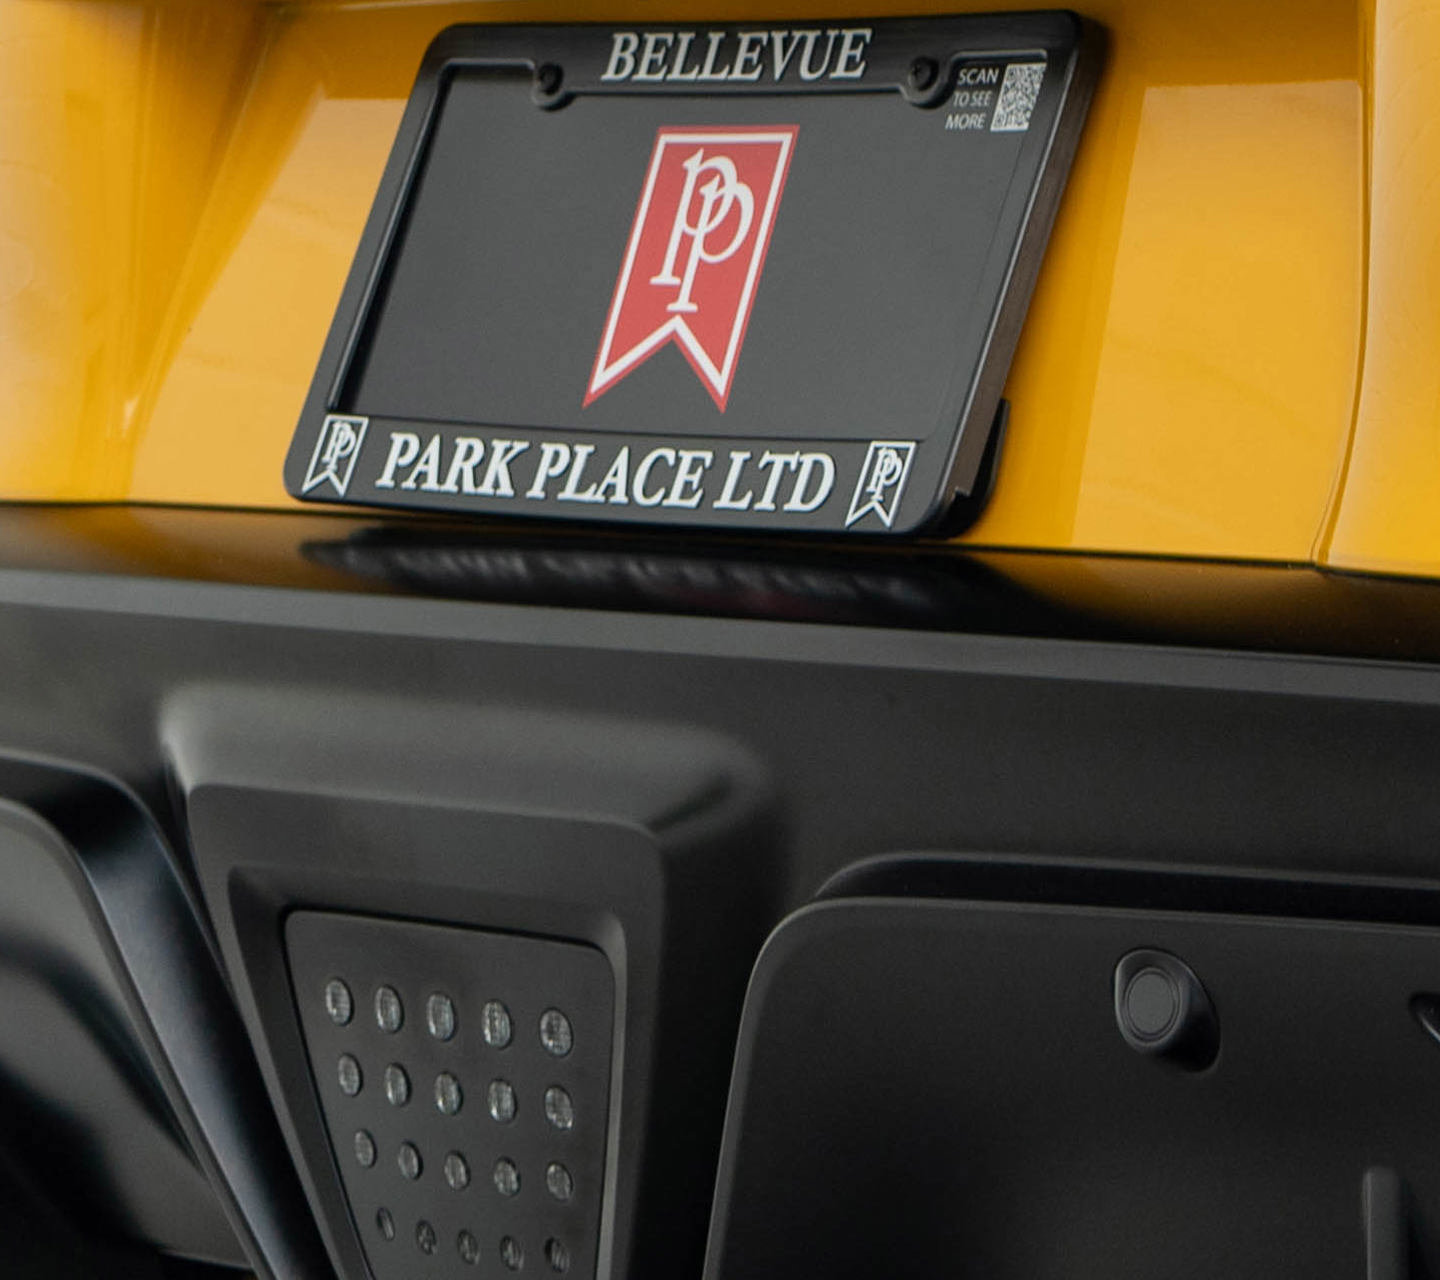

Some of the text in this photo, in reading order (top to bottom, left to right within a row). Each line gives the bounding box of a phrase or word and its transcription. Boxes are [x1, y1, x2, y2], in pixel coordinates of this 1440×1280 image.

[601, 27, 872, 82] BELLEVUE
[956, 67, 999, 85] SCAN
[953, 90, 992, 107] TO SEE
[944, 112, 987, 130] MORE
[375, 431, 836, 513] PARK PLACE LTD
